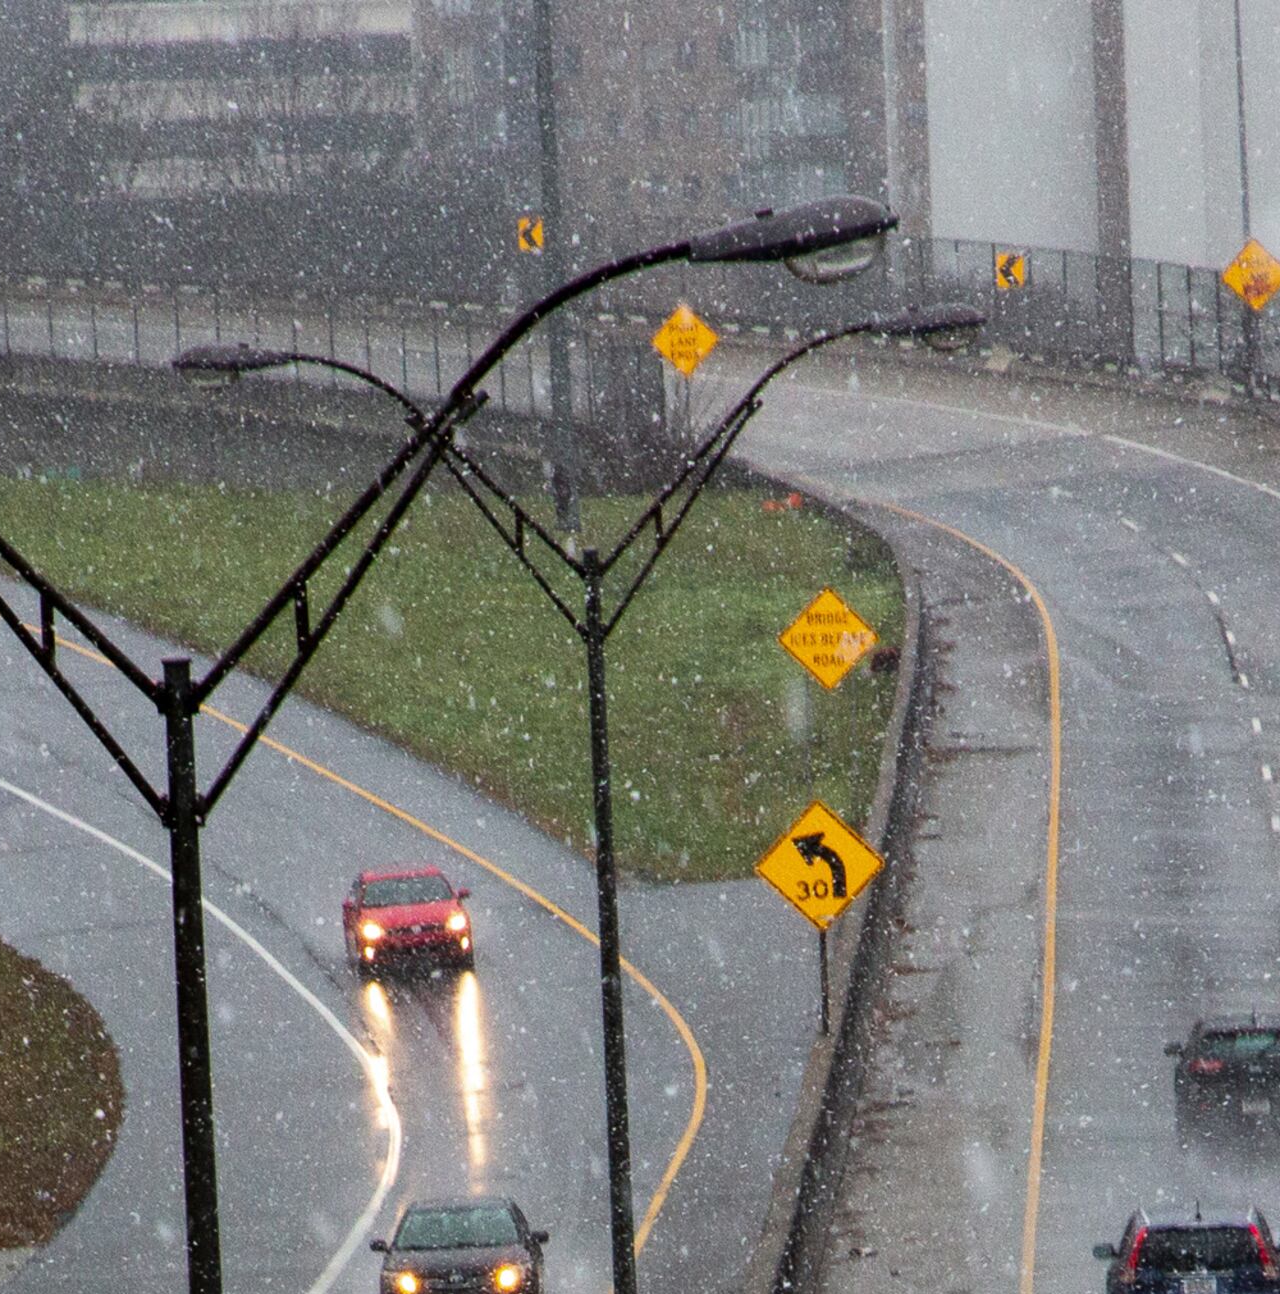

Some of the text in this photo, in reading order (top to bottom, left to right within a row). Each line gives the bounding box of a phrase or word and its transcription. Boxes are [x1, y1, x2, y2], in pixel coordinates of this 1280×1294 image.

[807, 610, 847, 625] BRIDGE
[790, 631, 866, 648] ICES BEFE
[813, 653, 845, 667] ROAD
[796, 880, 828, 901] 30
